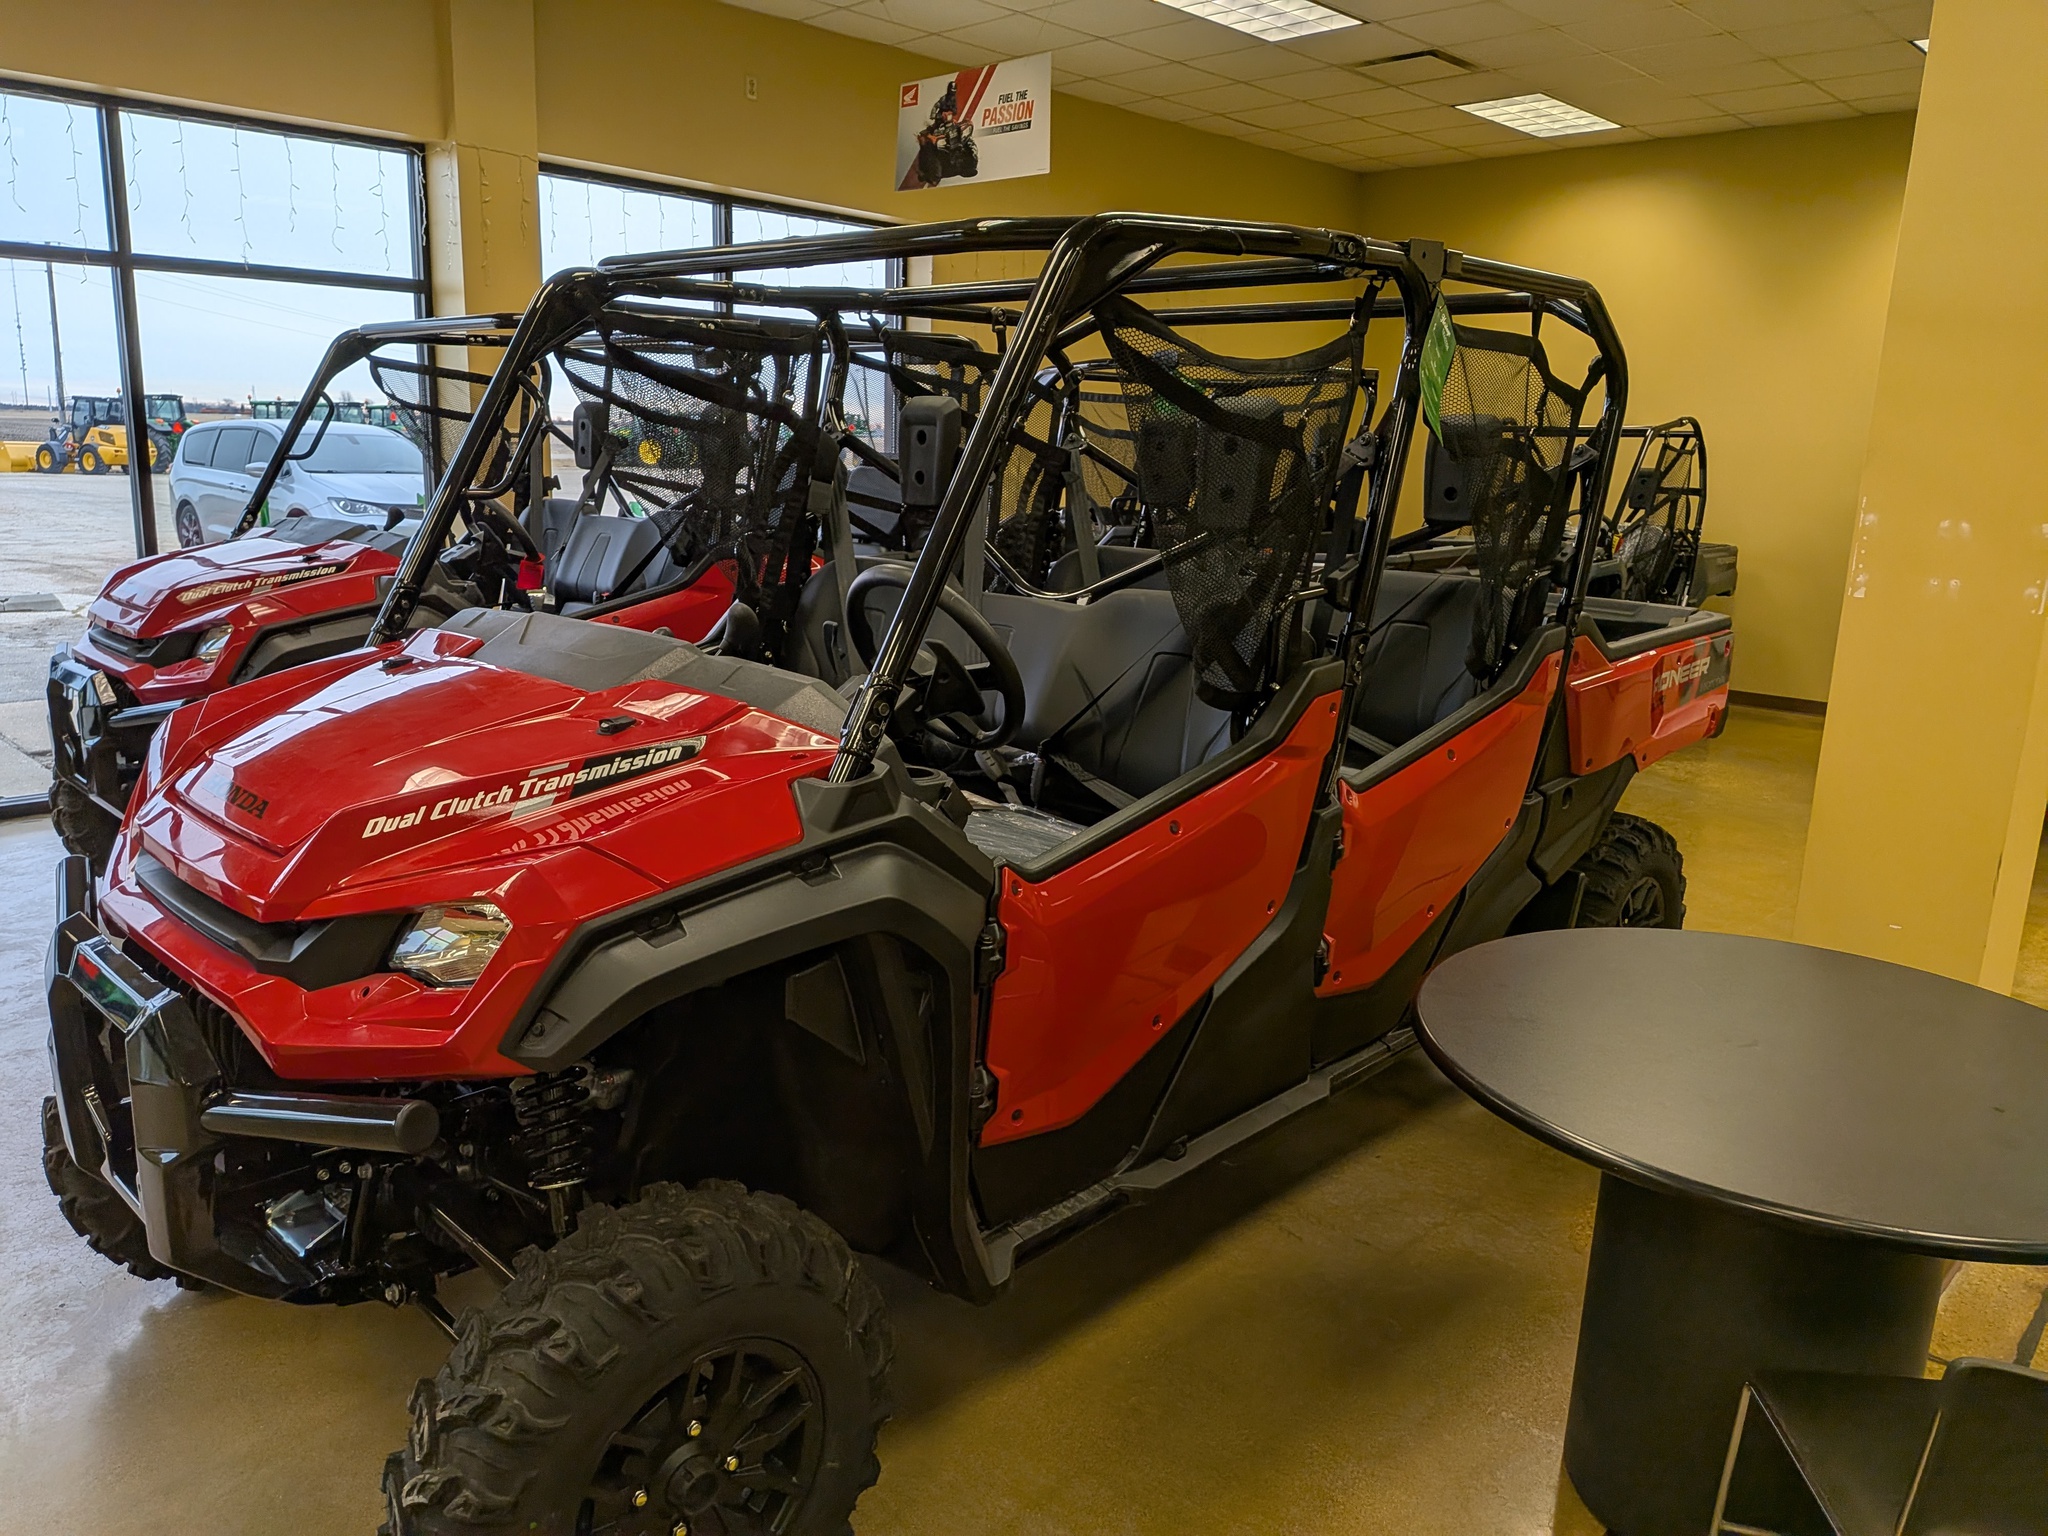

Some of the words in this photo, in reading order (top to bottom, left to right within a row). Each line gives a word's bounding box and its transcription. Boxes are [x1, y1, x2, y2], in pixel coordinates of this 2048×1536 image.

[998, 92, 1014, 105] FUEL
[1015, 89, 1028, 102] THE
[982, 100, 1034, 127] PASSION
[181, 589, 210, 602] Dual
[212, 580, 252, 595] Clutch
[254, 565, 337, 587] Transmission
[361, 805, 428, 839] Dual
[430, 784, 514, 822] Clutch
[518, 746, 684, 798] Transmission
